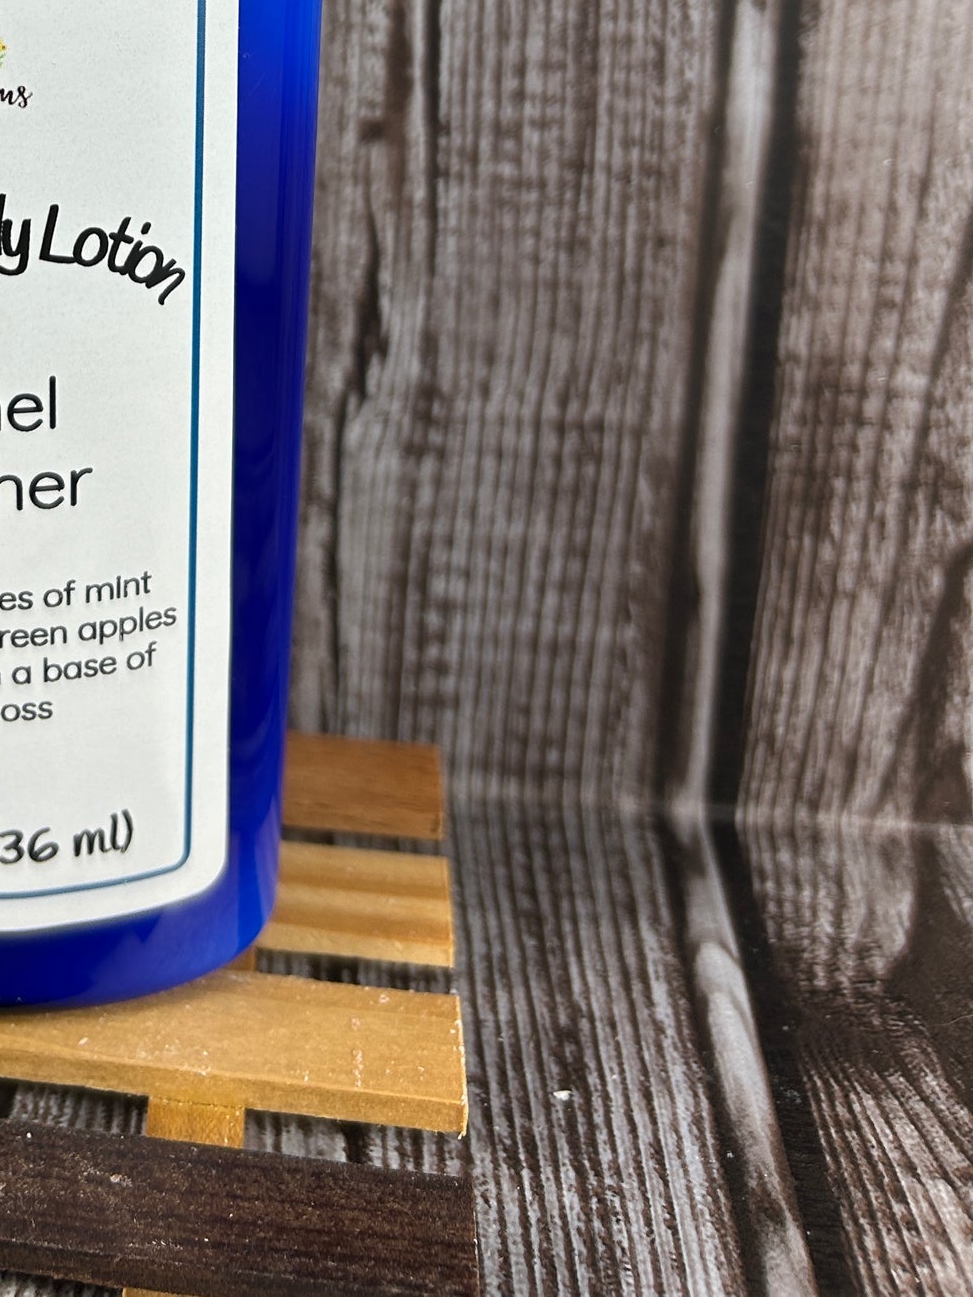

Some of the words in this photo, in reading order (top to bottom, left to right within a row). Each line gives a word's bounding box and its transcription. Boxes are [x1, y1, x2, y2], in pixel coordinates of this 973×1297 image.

[38, 203, 186, 306] Lotion
[42, 579, 76, 608] of
[85, 571, 152, 604] mint
[77, 606, 177, 646] apples
[11, 666, 32, 685] a
[43, 656, 117, 683] base
[126, 641, 157, 671] of
[73, 809, 134, 858] ml)
